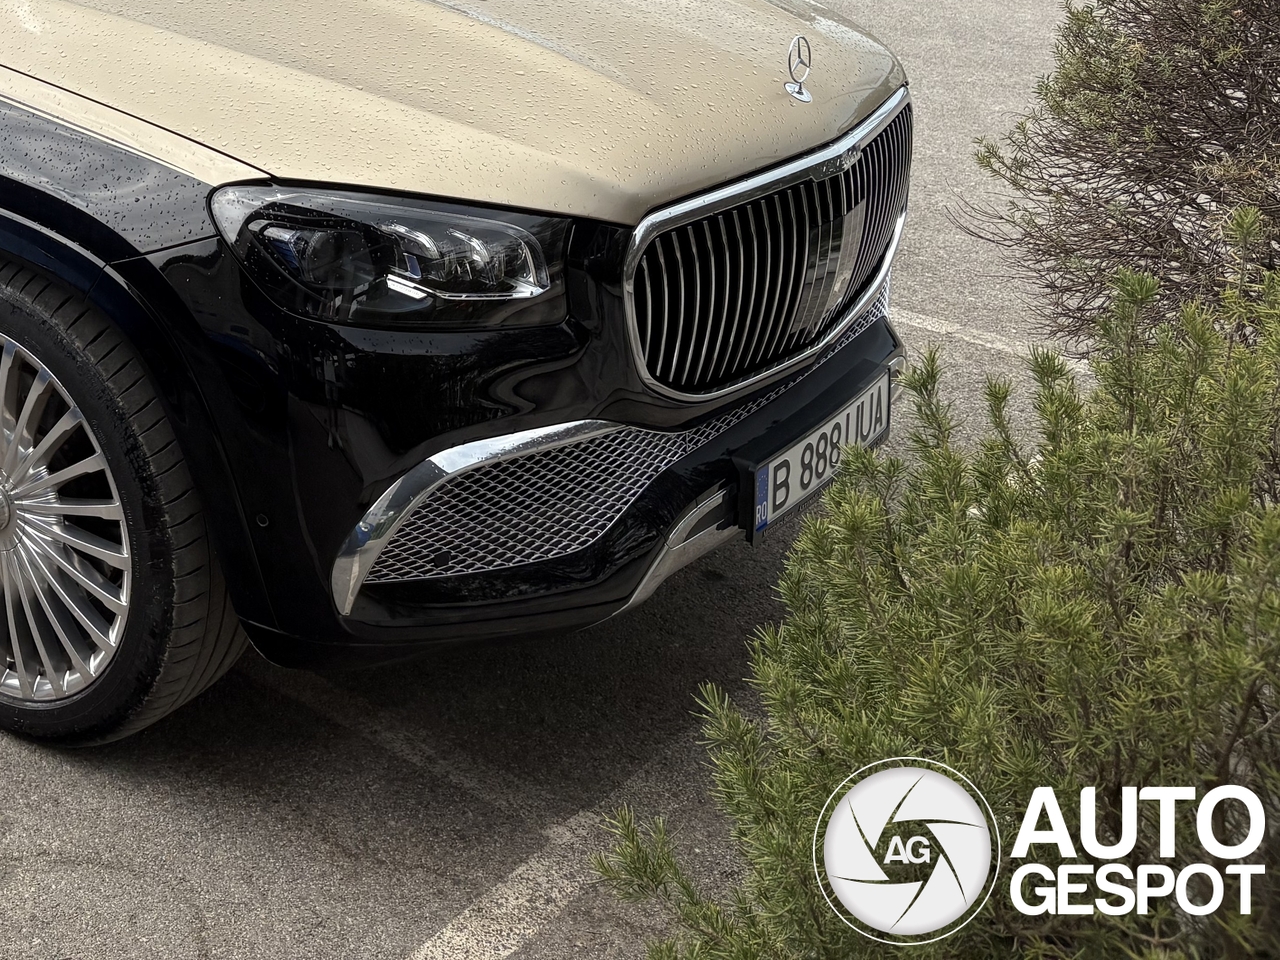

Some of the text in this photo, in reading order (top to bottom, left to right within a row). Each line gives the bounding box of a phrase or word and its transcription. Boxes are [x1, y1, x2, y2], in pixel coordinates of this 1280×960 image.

[773, 458, 790, 514] B
[800, 422, 841, 490] 888
[755, 500, 768, 525] RO
